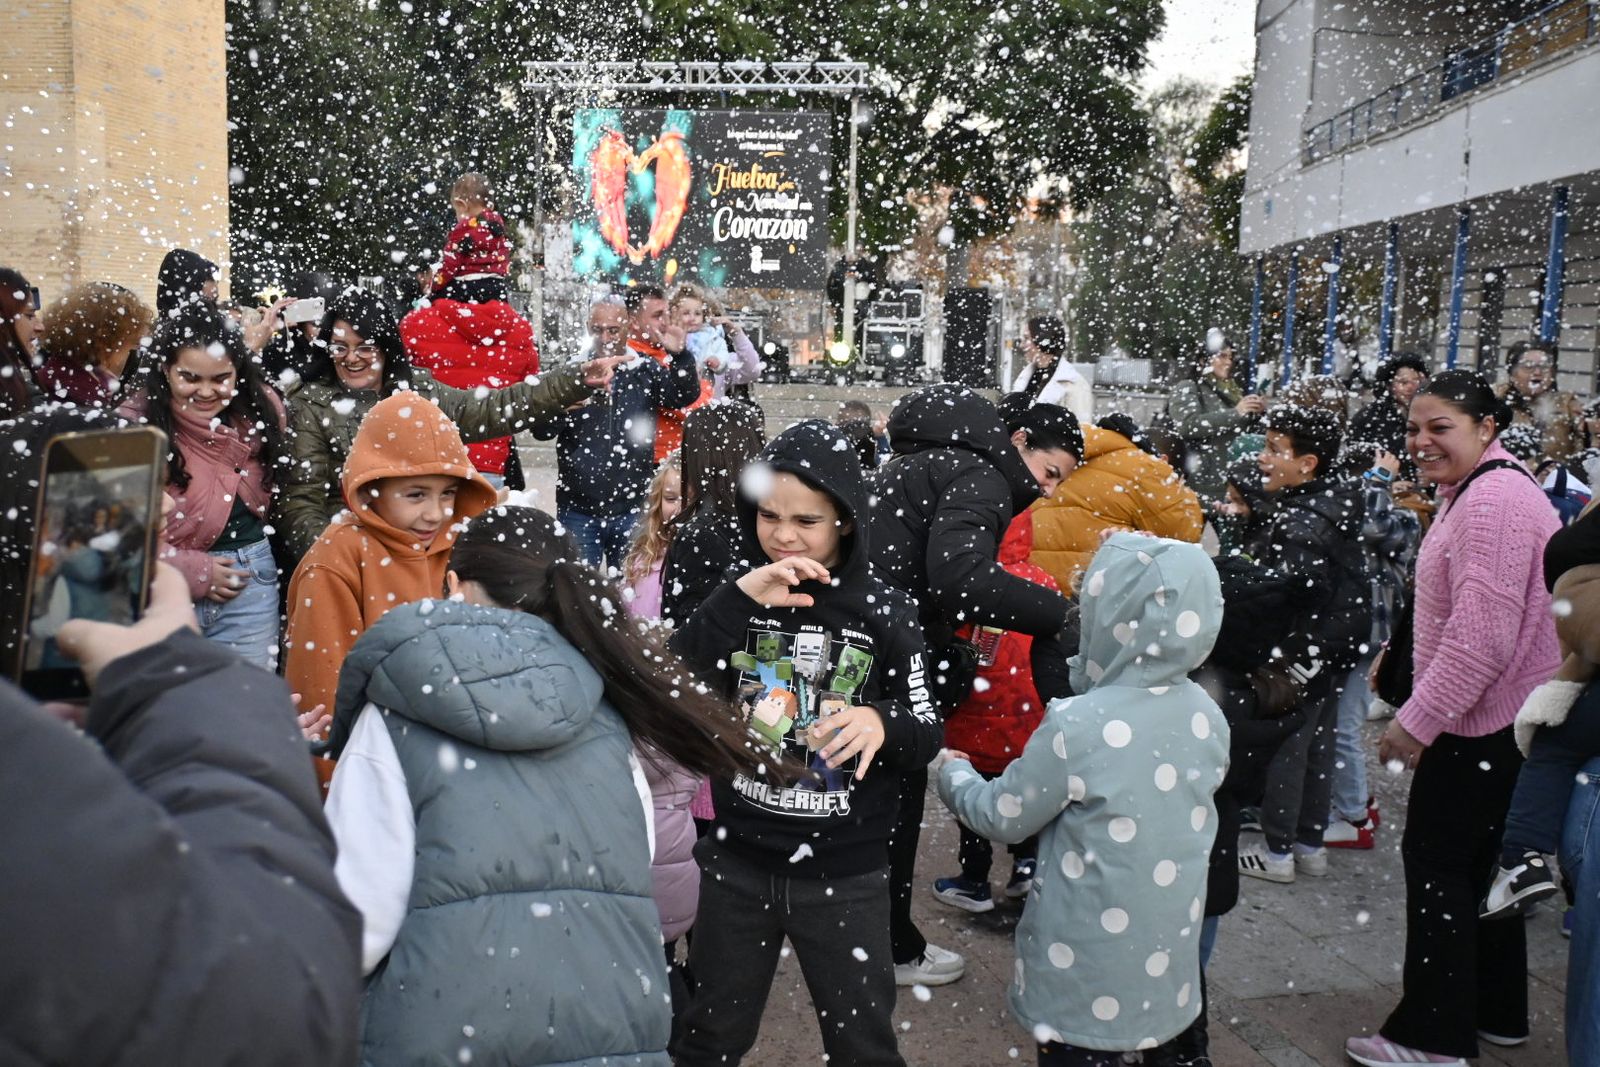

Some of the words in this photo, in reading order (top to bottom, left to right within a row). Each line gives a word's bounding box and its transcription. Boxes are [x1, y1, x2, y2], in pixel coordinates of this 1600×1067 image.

[708, 163, 777, 196] Huelva
[841, 628, 873, 644] SURVIVE
[733, 775, 848, 811] MINECRAFT
